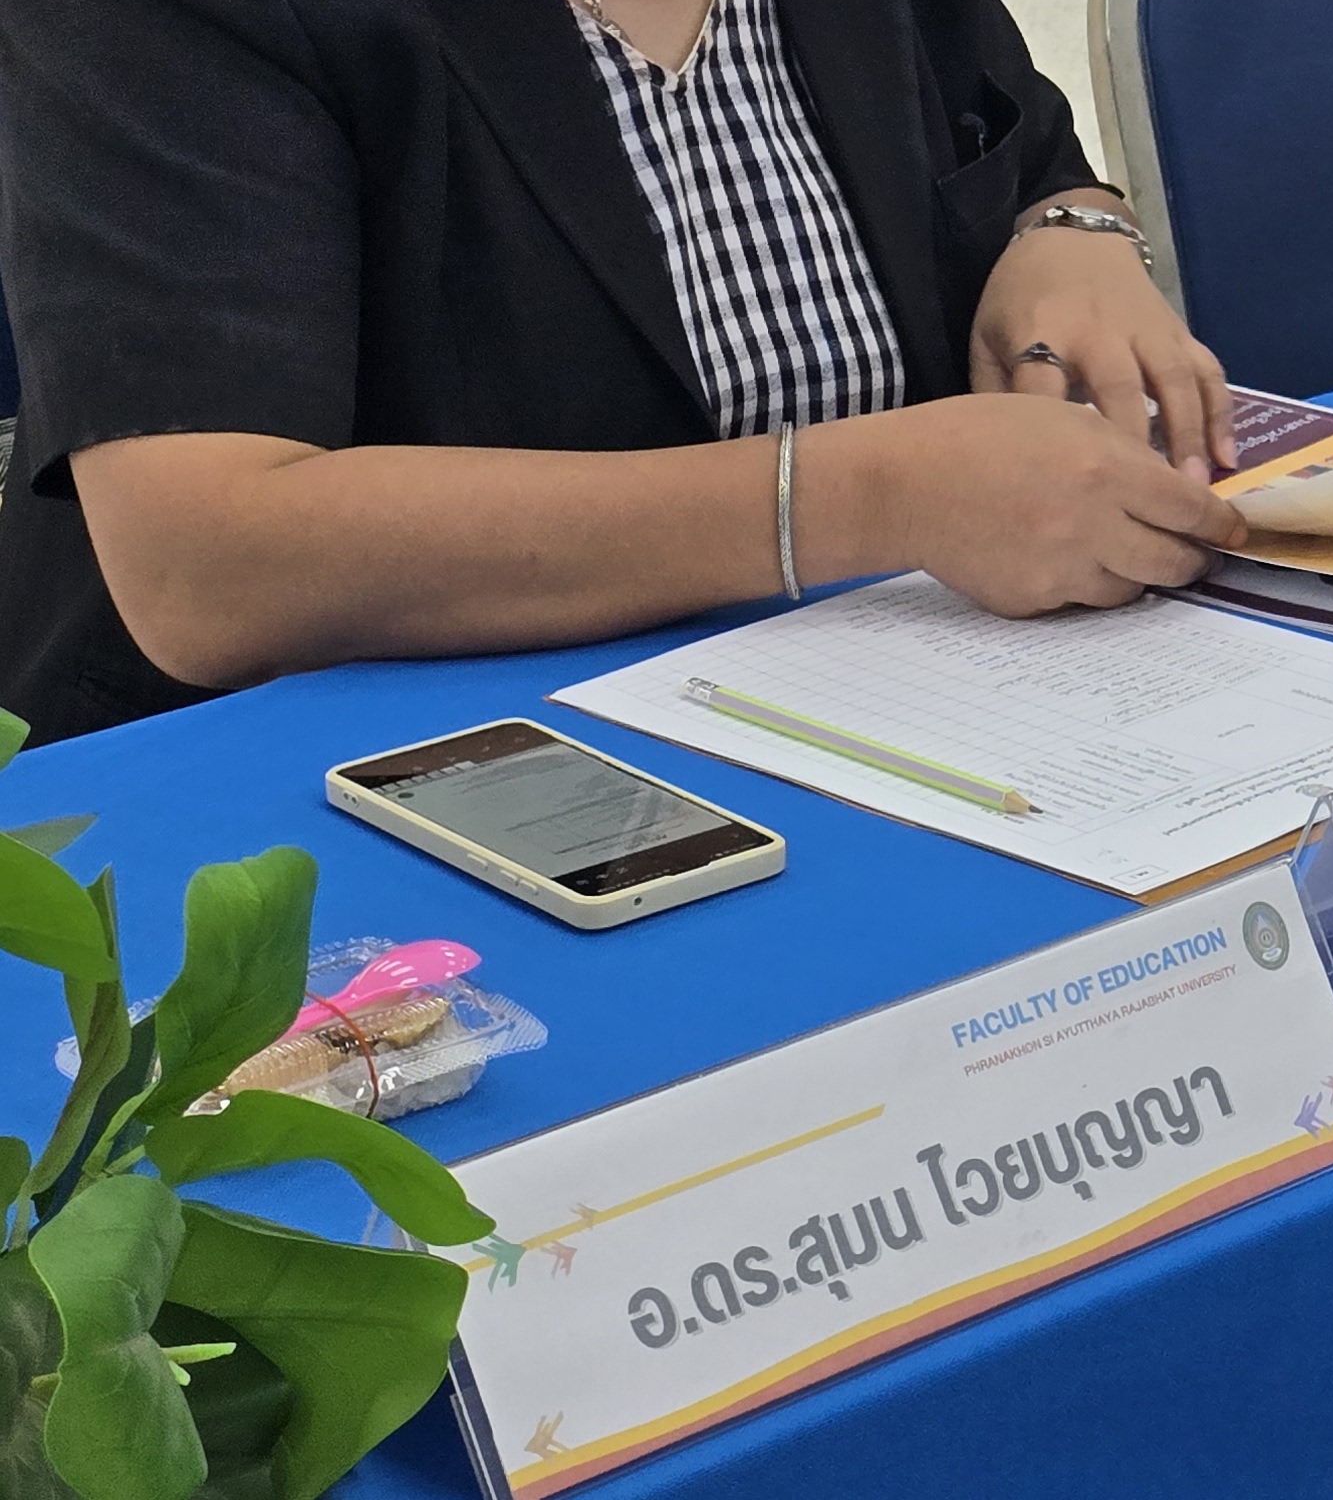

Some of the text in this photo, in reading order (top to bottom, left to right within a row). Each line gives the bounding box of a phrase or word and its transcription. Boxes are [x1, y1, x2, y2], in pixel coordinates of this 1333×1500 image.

[951, 926, 1228, 1048] FACULTY OF EDUCATION
[963, 963, 1238, 1078] PHRANAKHON SI AYUTTHAYA RAJABHAT UNIVERSITY
[626, 1065, 1235, 1351] อ.ดร.สุมน ไวยบุญญา
